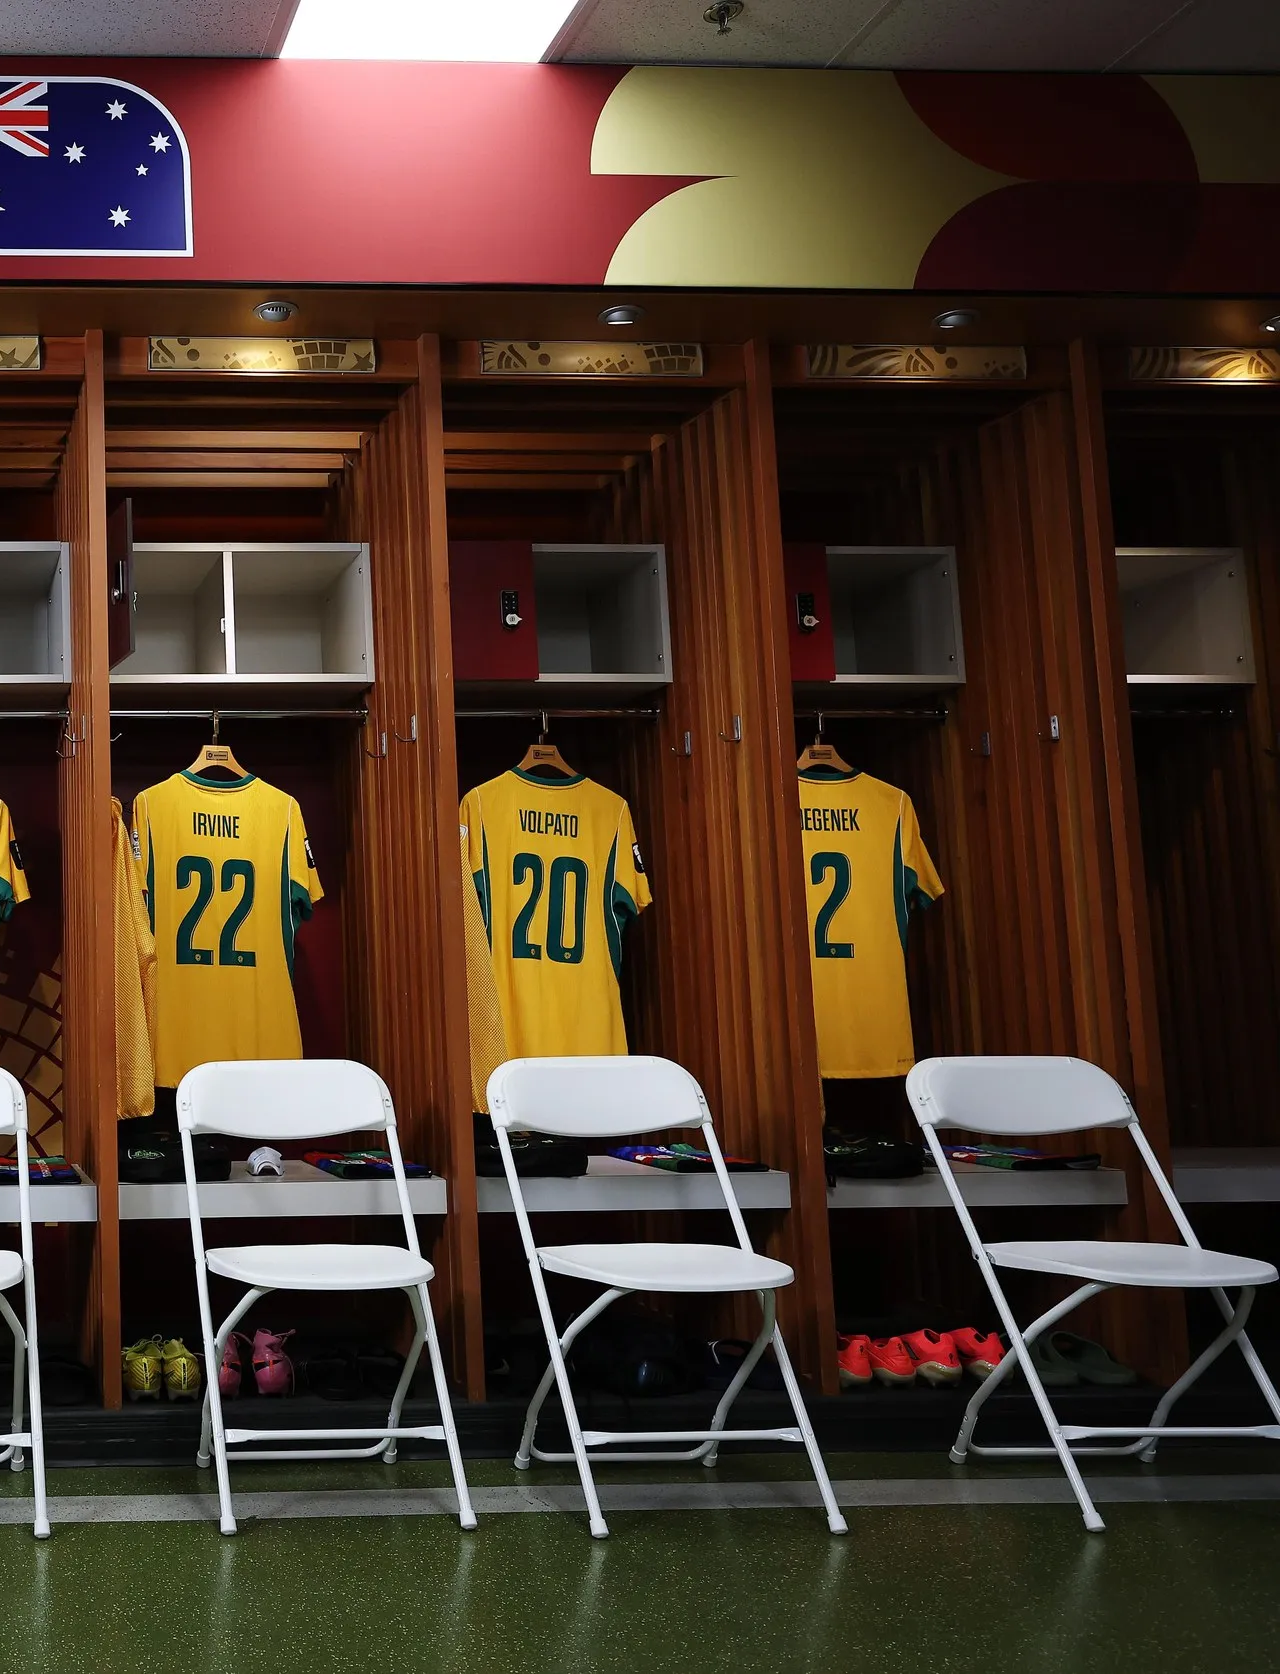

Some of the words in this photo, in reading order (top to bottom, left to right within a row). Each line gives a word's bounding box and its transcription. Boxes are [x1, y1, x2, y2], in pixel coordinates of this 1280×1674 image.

[193, 812, 240, 839] IRVINE
[519, 809, 579, 838] VOLPATO
[176, 856, 257, 967] 22
[512, 853, 588, 964] 20
[810, 852, 855, 958] 2
